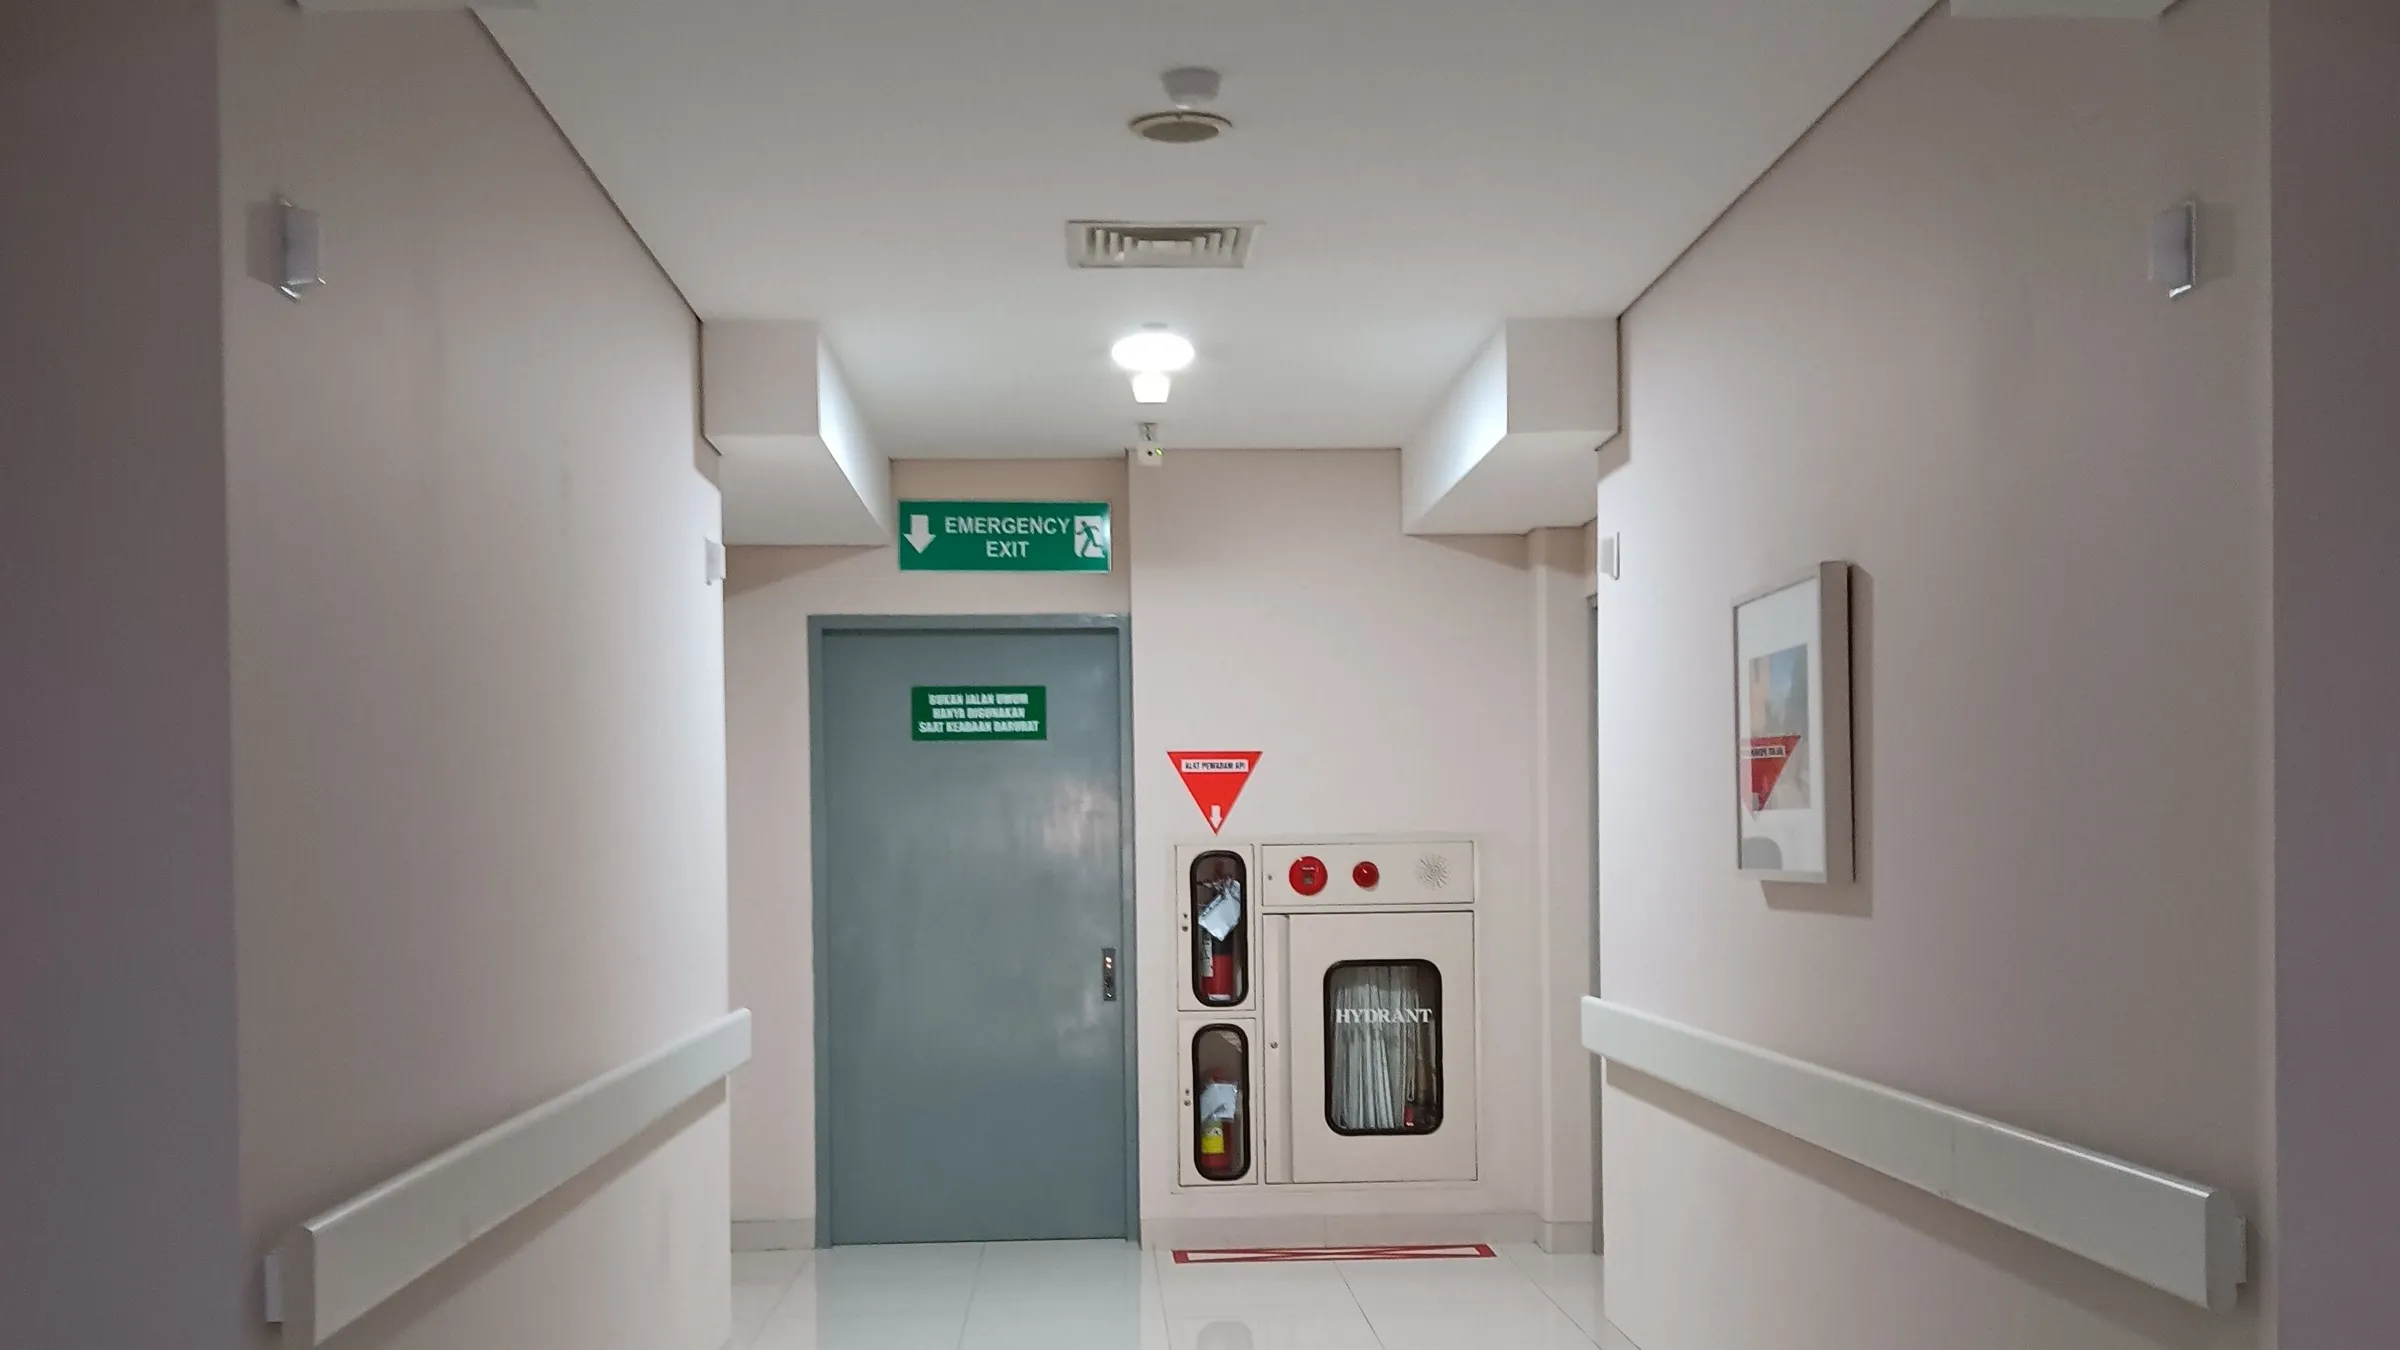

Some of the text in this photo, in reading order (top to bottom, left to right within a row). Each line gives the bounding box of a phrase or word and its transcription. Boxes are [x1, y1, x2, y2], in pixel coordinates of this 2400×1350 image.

[944, 515, 1071, 535] EMERGENCY
[985, 540, 1030, 558] EXIT
[928, 693, 964, 705] BUKAN
[965, 693, 995, 705] JALAN
[932, 707, 966, 719] HANYA
[918, 720, 1040, 733] SAAT KEADAAN DARURAT
[1336, 1008, 1433, 1024] HYDRANT
